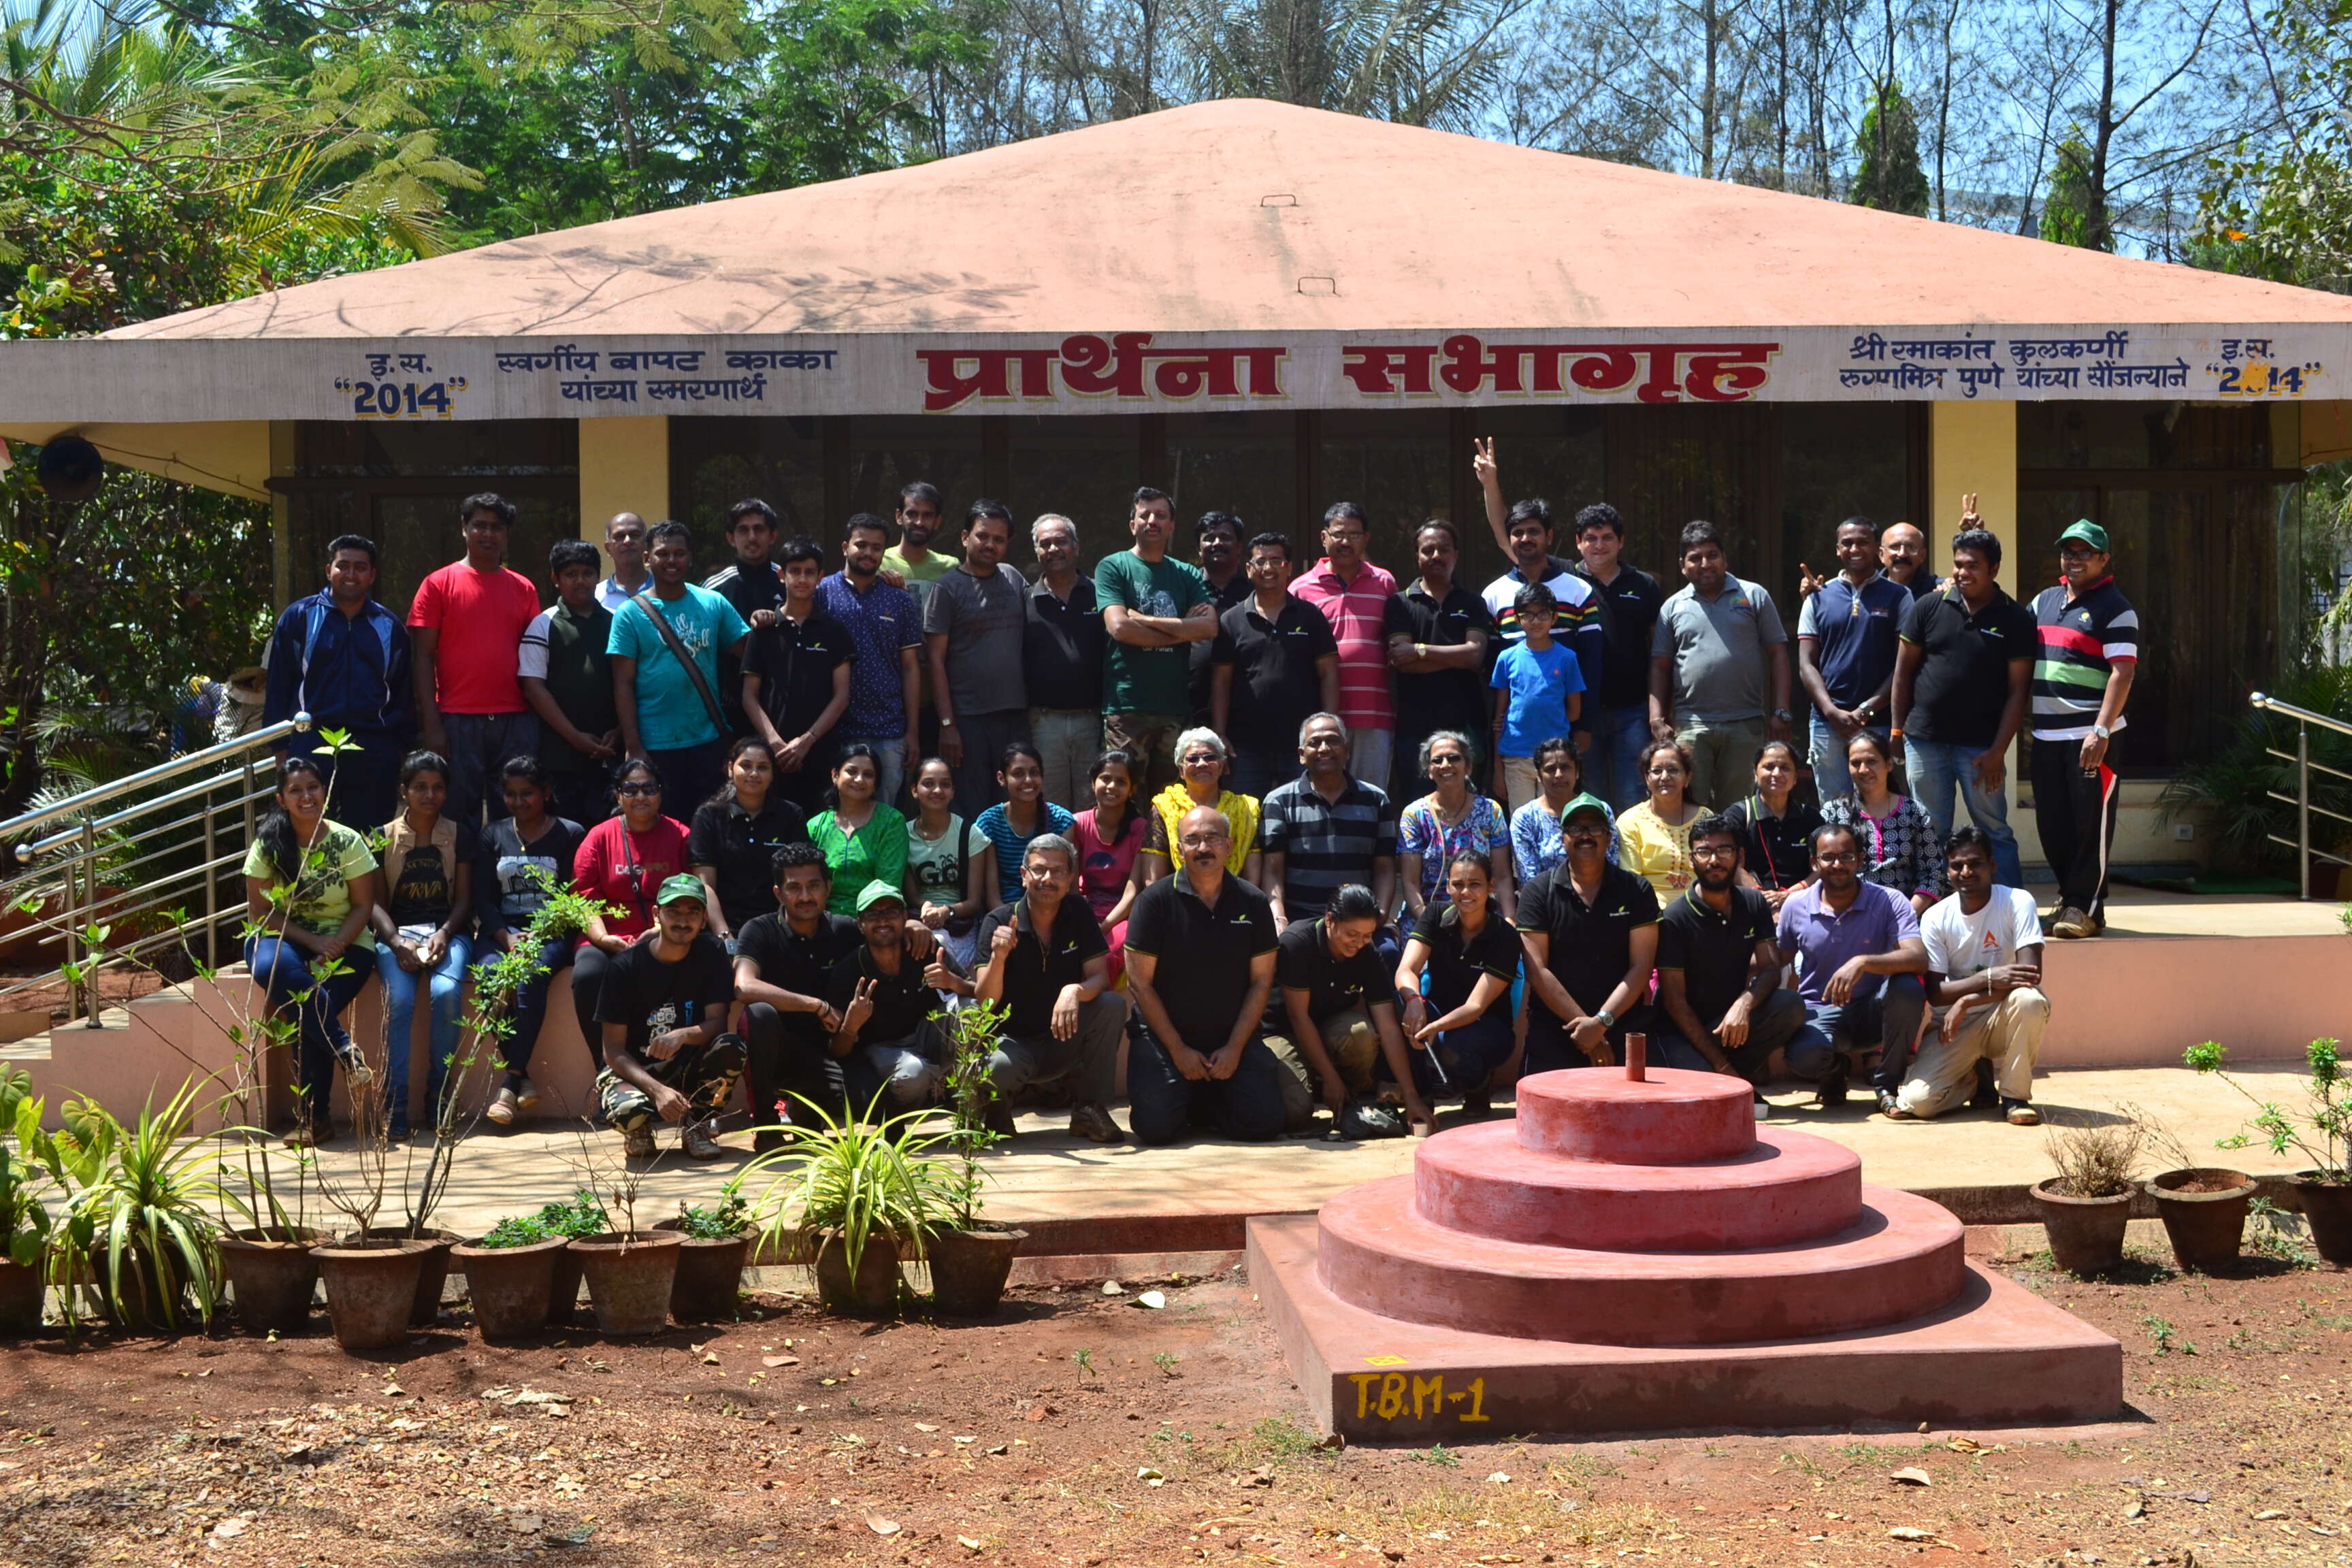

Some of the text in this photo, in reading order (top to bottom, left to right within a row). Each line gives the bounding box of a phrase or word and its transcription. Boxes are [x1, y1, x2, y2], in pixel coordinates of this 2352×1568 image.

[495, 344, 838, 374] स्वर्गीय बापट काका
[1849, 330, 2129, 366] श्री रमाकांत कुलकर्णी
[561, 373, 768, 402] यांच्या स्मरणार्थ
[916, 332, 1780, 412] प्रार्थना सभागृह
[1957, 362, 2006, 398] पुणे
[2016, 362, 2080, 389] यांच्या
[1348, 1372, 1491, 1422] T.B.M-1
